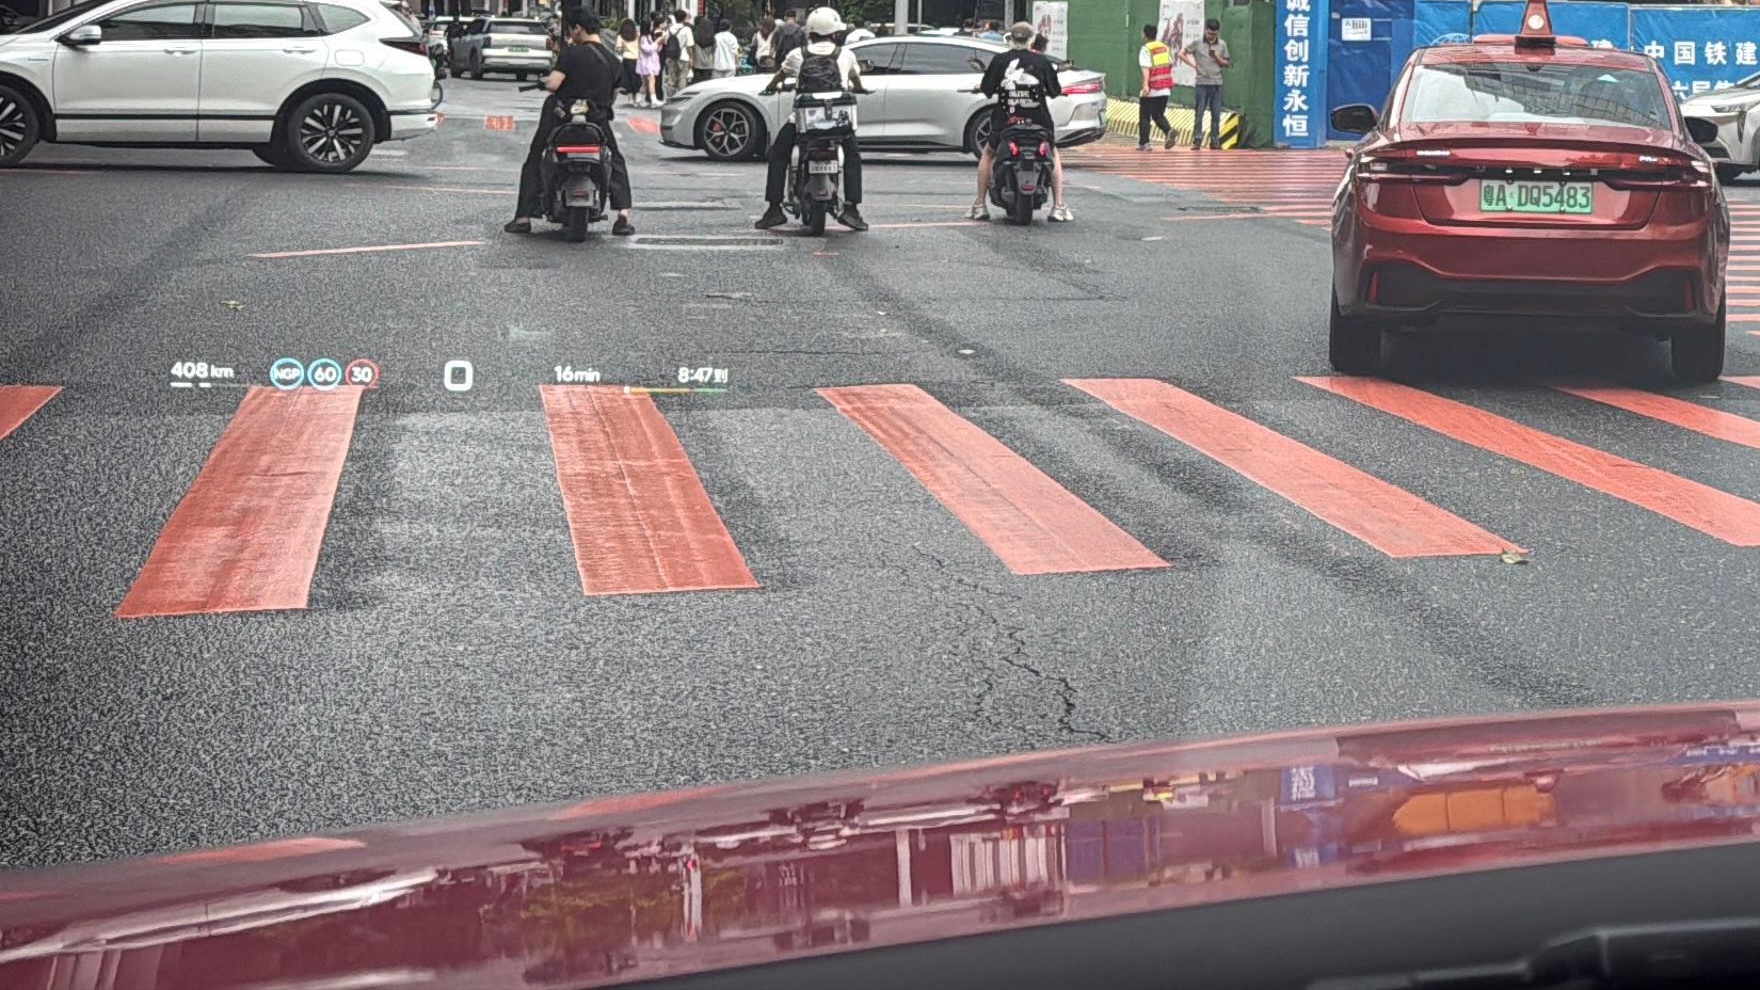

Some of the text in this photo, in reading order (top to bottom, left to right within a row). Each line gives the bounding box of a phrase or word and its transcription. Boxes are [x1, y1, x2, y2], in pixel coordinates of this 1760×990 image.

[1644, 40, 1759, 66] 中国铁建
[274, 367, 301, 381] NGP
[314, 367, 337, 382] 60
[351, 367, 372, 382] 30
